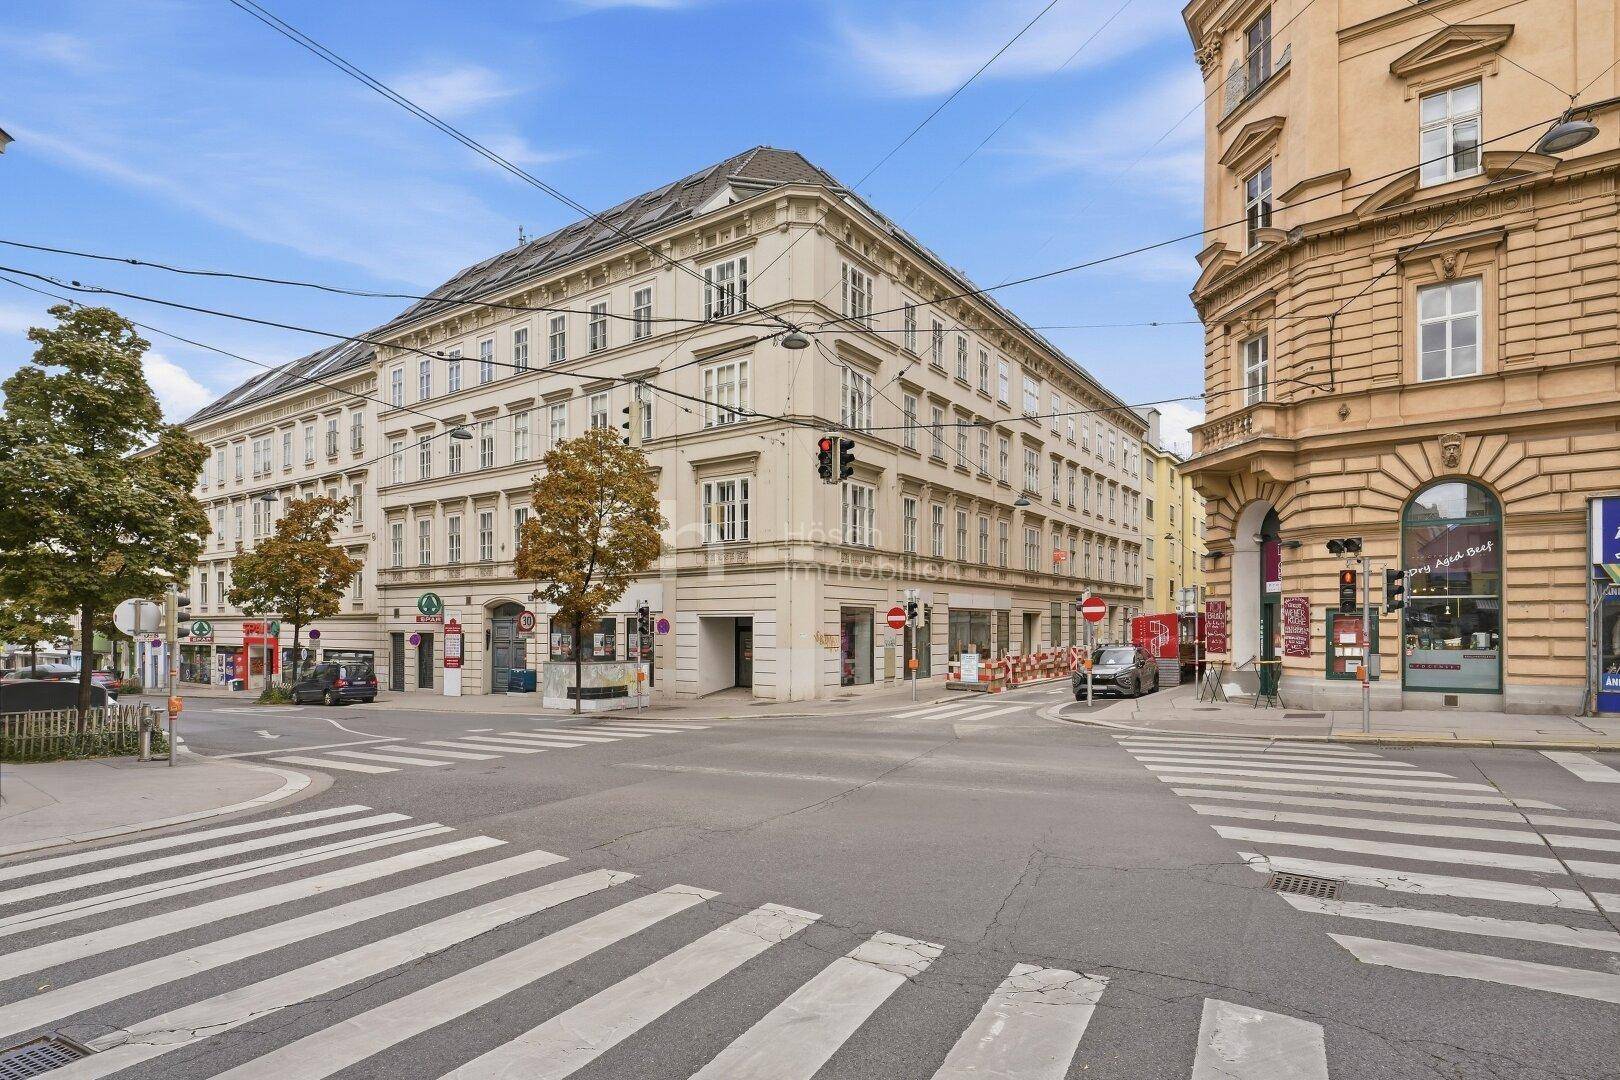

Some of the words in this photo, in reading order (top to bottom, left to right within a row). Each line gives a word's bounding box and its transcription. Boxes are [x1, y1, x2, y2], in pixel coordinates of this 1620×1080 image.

[1409, 564, 1431, 576] Dry
[1435, 552, 1465, 568] Aged
[1467, 540, 1494, 557] Beef
[522, 616, 532, 625] 30
